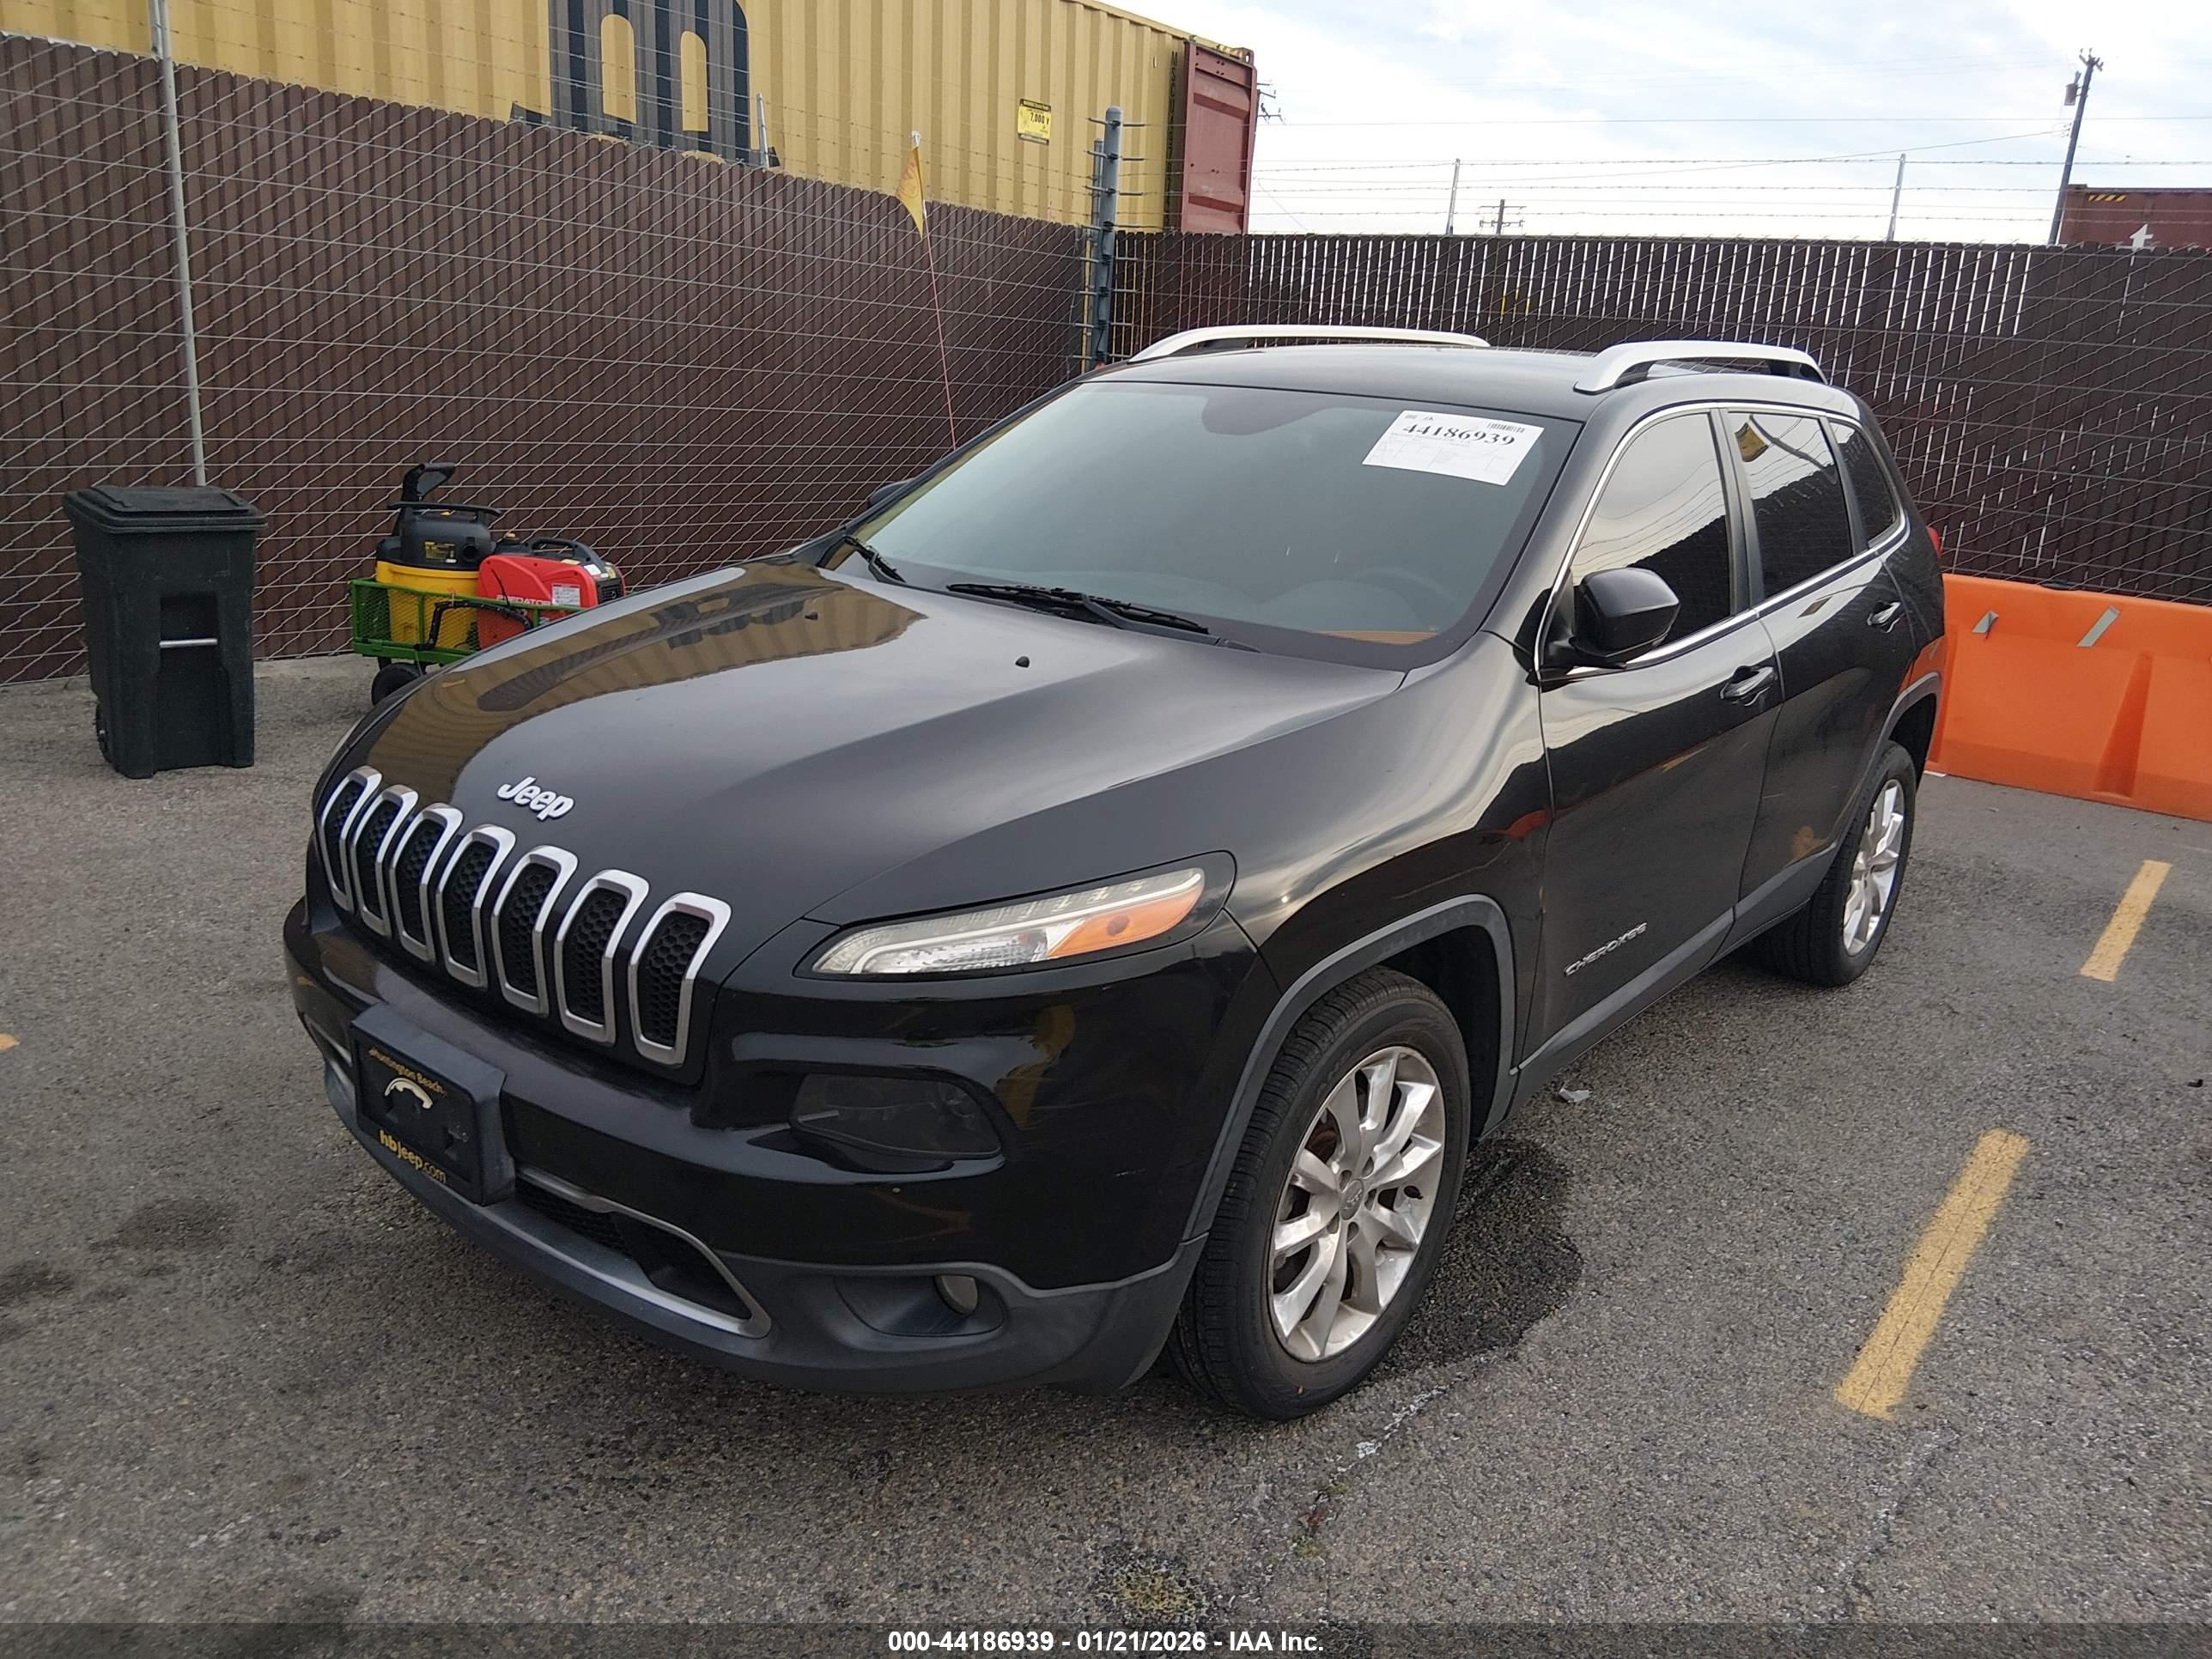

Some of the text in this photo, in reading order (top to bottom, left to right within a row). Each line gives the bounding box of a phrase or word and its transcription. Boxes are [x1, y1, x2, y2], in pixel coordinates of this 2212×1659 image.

[1030, 112, 1045, 125] 7,000
[1401, 423, 1516, 447] 44186939
[497, 775, 574, 821] Jeep
[1565, 921, 1648, 976] CHEROKEE
